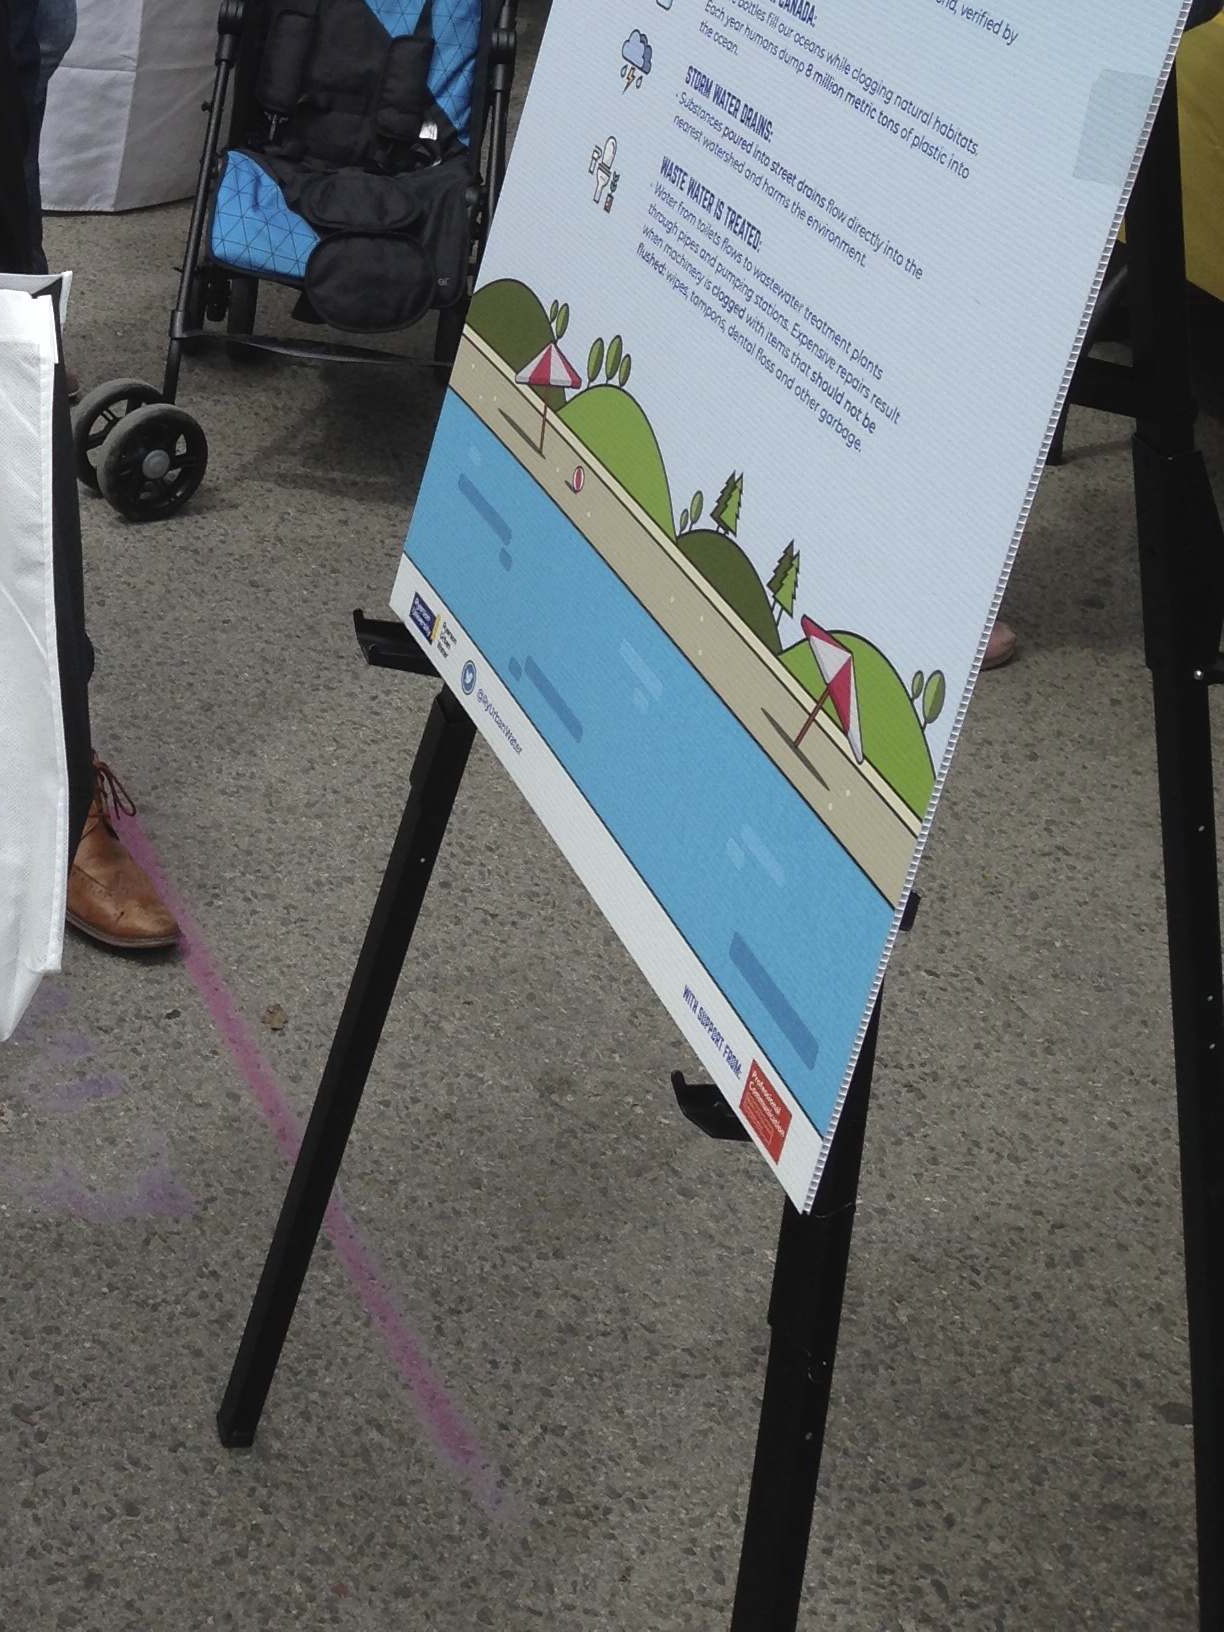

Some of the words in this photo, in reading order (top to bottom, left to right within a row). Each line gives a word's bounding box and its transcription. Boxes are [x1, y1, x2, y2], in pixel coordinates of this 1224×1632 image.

[712, 30, 738, 56] ocean.
[959, 3, 1004, 35] verified
[1000, 22, 1019, 46] by
[684, 64, 714, 99] STORM
[711, 83, 741, 119] WATER
[739, 102, 773, 143] DRAINS:
[722, 14, 745, 33] year
[743, 23, 779, 56] humans
[777, 47, 805, 74] dump
[811, 70, 845, 99] million
[843, 90, 877, 120] metric
[876, 109, 900, 135] tons
[909, 134, 947, 165] plastic
[946, 152, 970, 179] into
[792, 31, 826, 59] oceans
[825, 51, 851, 75] while
[850, 66, 894, 105] clogging
[892, 94, 934, 126] natural
[659, 155, 688, 191] WASTE
[685, 176, 715, 214] WATER
[723, 205, 762, 253] TREATED:
[672, 114, 703, 143] nearest
[701, 135, 746, 174] watershed
[743, 167, 764, 187] and
[760, 177, 791, 209] harms
[678, 90, 723, 132] Substances
[720, 124, 755, 154] poured
[751, 143, 771, 167] into
[769, 160, 797, 187] street
[795, 178, 827, 209] drains
[846, 215, 884, 253] directly
[882, 239, 904, 266] into
[903, 257, 923, 280] the
[641, 224, 664, 248] when
[662, 242, 705, 286] machinery
[710, 284, 747, 320] clogged
[744, 312, 765, 337] with
[763, 330, 791, 359] items
[789, 350, 811, 377] that
[809, 370, 845, 406] should
[842, 398, 862, 422] not
[647, 202, 678, 236] through
[675, 229, 700, 254] pipes
[698, 247, 718, 268] and
[713, 261, 755, 303] pumping
[752, 293, 789, 331] stations.
[789, 321, 836, 370] Expensive
[835, 363, 871, 399] repairs
[869, 392, 901, 425] result
[653, 180, 678, 209] Water
[676, 200, 697, 226] from
[752, 265, 804, 313] wastewater
[802, 305, 852, 355] treatment
[848, 347, 883, 380] plants
[635, 241, 667, 276] flushed:
[726, 323, 757, 355] dental
[754, 346, 776, 374] floss
[774, 367, 796, 390] and
[793, 384, 820, 412] other
[817, 407, 861, 453] garbage.
[682, 984, 699, 1014] WITH
[696, 1005, 725, 1051] SUPPORT
[721, 1043, 742, 1080] FROM:
